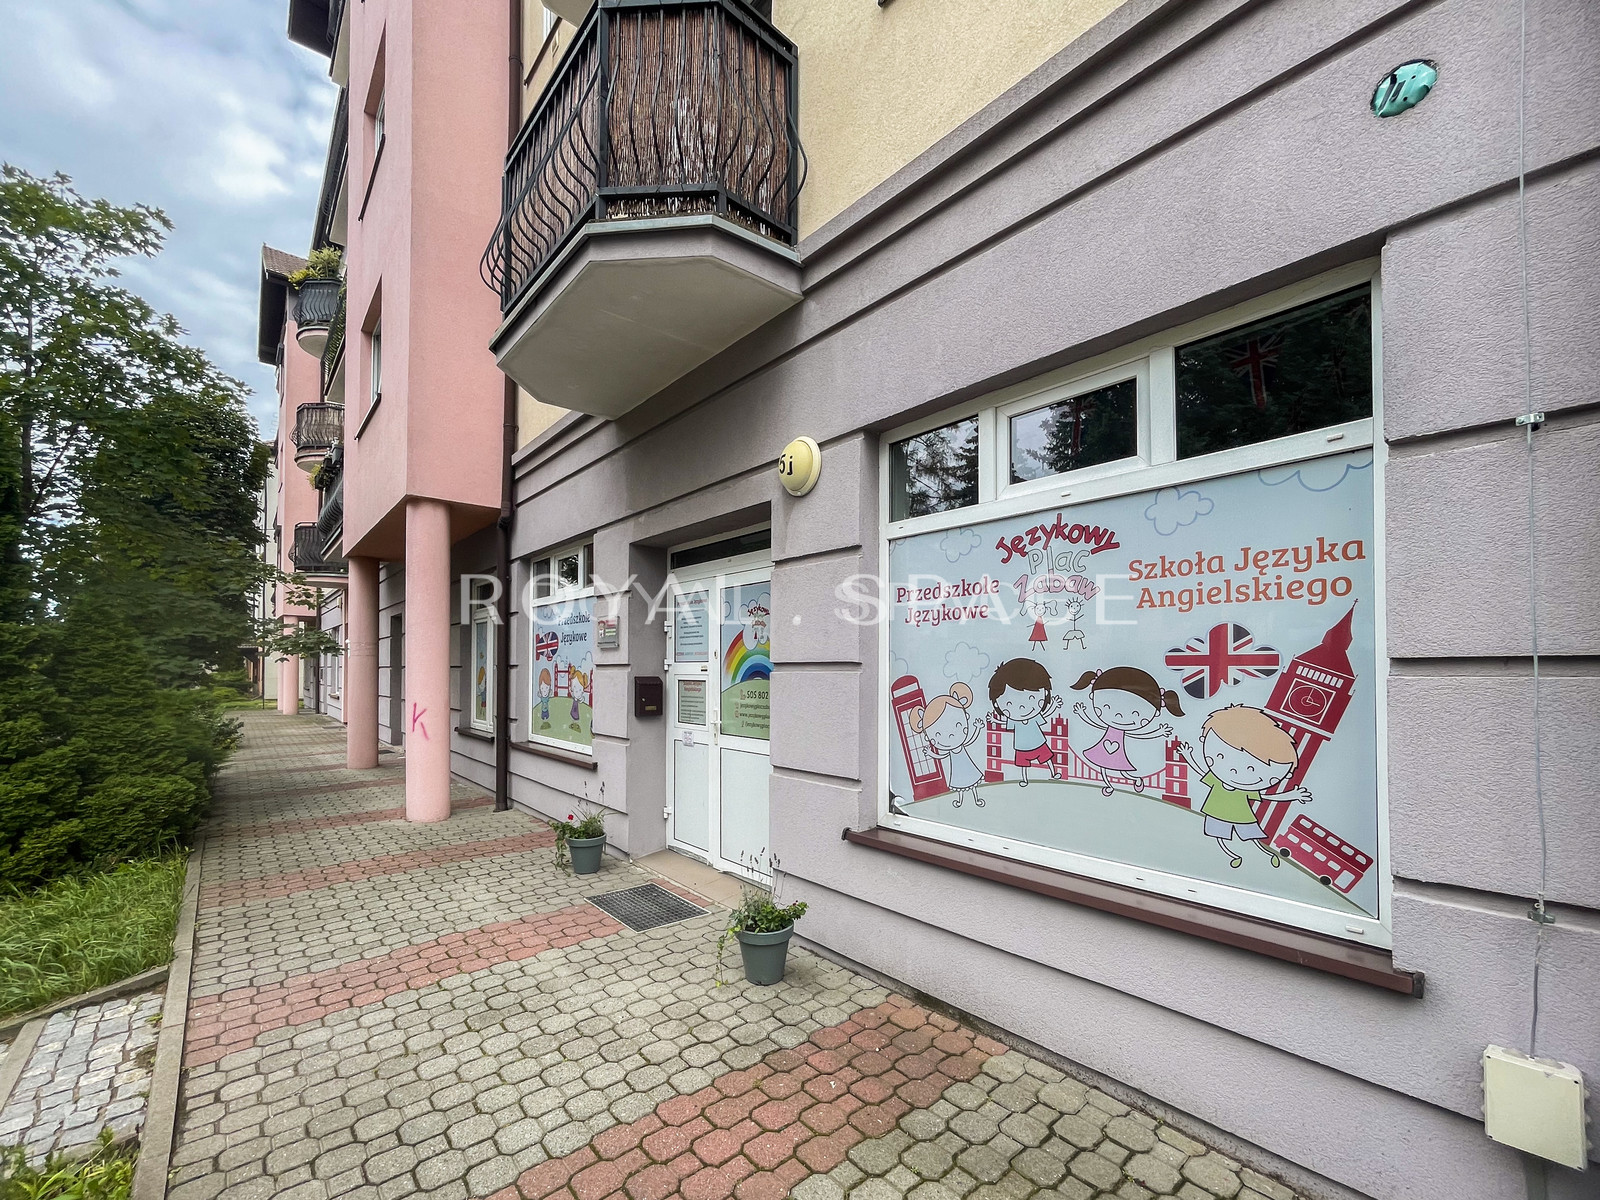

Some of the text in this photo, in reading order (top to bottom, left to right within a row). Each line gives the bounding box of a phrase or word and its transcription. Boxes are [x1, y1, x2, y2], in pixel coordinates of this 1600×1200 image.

[995, 511, 1121, 564] Językowy
[1027, 545, 1091, 575] Plac
[1128, 536, 1366, 582] Szkoła Języka
[896, 575, 1001, 603] Przedszkole
[1013, 568, 1101, 603] Zabaw
[1135, 574, 1353, 613] Angielskiego
[904, 603, 990, 627] Językowe
[561, 630, 588, 646] Językowe
